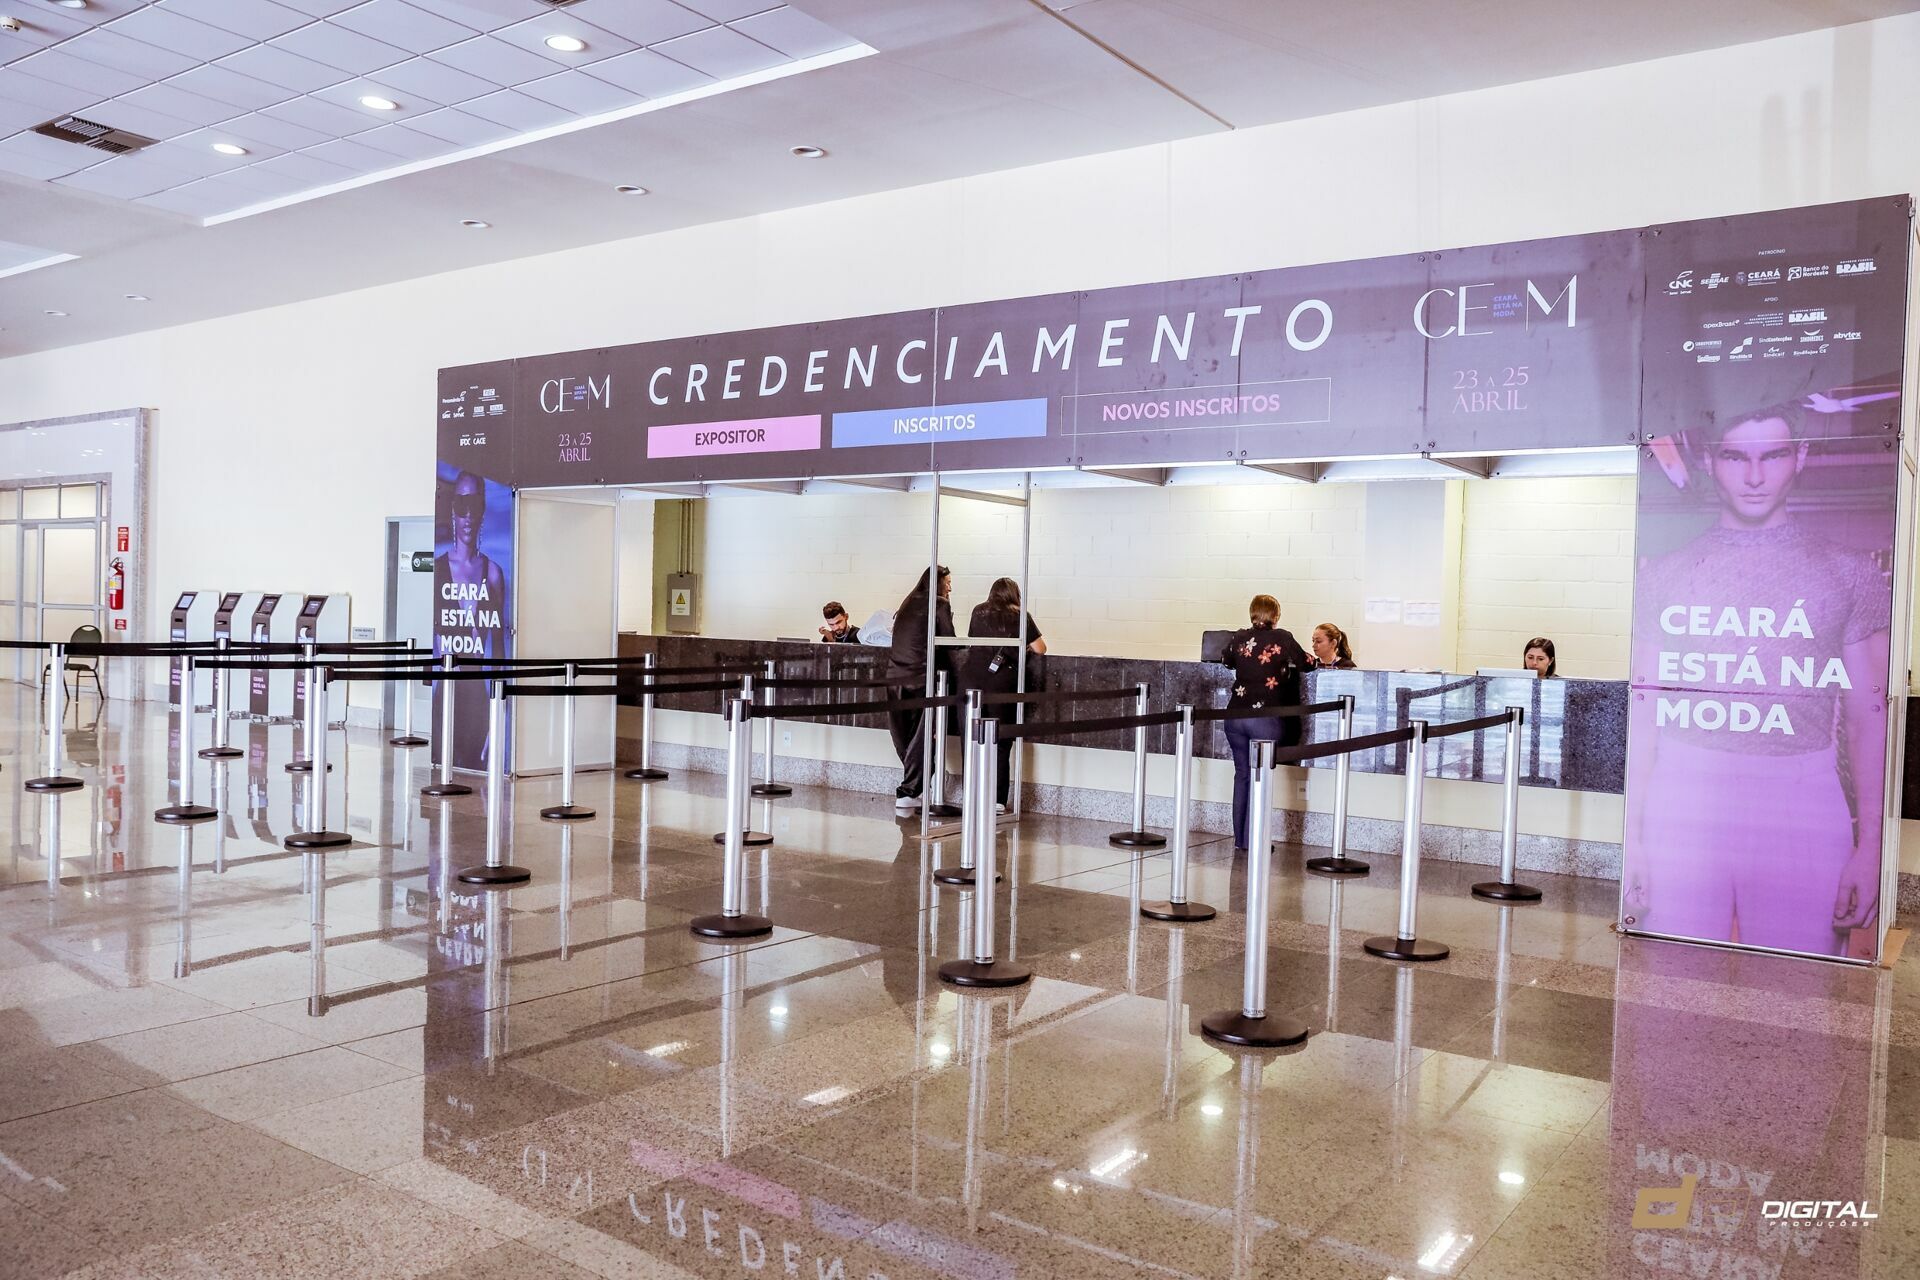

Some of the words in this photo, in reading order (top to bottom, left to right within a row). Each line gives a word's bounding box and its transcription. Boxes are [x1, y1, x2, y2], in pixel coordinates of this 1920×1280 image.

[1747, 268, 1781, 279] CEARÁ
[1836, 261, 1877, 274] BRASIL
[1668, 279, 1693, 289] CNC
[1788, 311, 1828, 323] BRASIL
[648, 299, 1333, 406] CREDENCIAMENTO
[1453, 369, 1478, 389] 23
[1503, 366, 1529, 386] 25
[1103, 401, 1170, 422] NOVOS
[1175, 394, 1280, 419] INSCRITOS
[1452, 389, 1528, 413] ABRIL
[893, 413, 976, 434] INSCRITOS
[559, 433, 570, 447] 23
[580, 432, 592, 446] 25
[695, 428, 766, 446] EXPOSITOR
[558, 447, 591, 463] ABRIL
[441, 578, 490, 601] CEARÁ
[441, 604, 476, 627] ESTÁ
[478, 609, 501, 628] NA
[1659, 599, 1815, 639] CEARÁ
[440, 634, 484, 655] MODA
[1658, 646, 1767, 686] ESTÁ
[1780, 656, 1853, 690] NA
[1656, 697, 1796, 736] MODA
